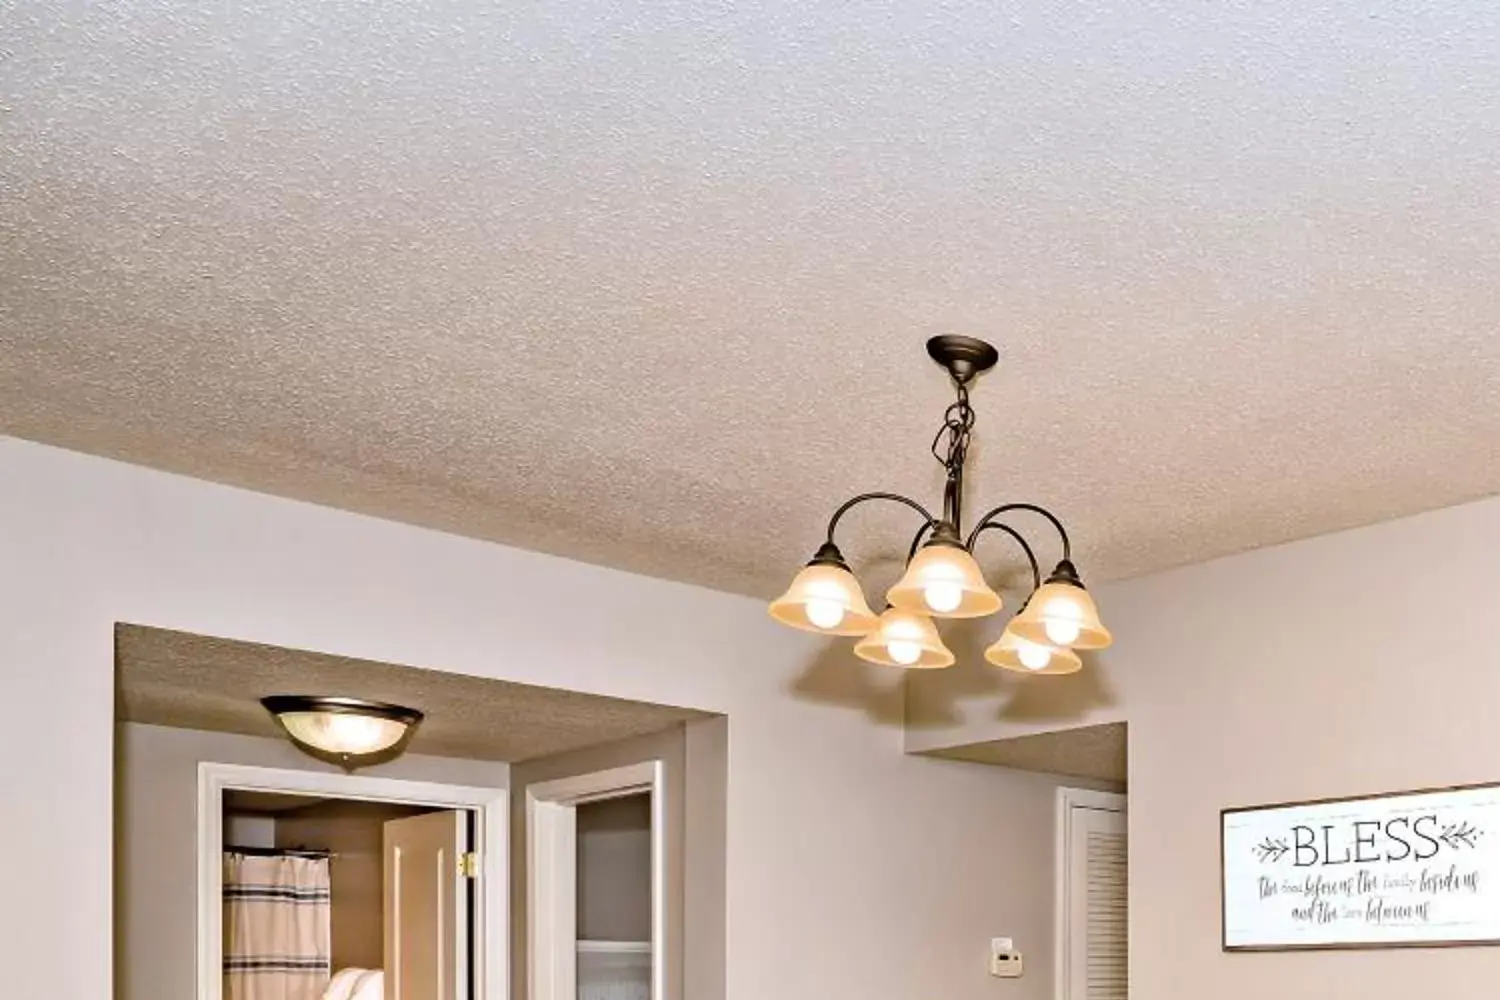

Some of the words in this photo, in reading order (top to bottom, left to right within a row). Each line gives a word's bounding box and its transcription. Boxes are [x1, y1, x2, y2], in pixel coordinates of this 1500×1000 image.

[1291, 814, 1439, 867] BLESS
[1356, 869, 1377, 895] the
[1463, 870, 1480, 894] us
